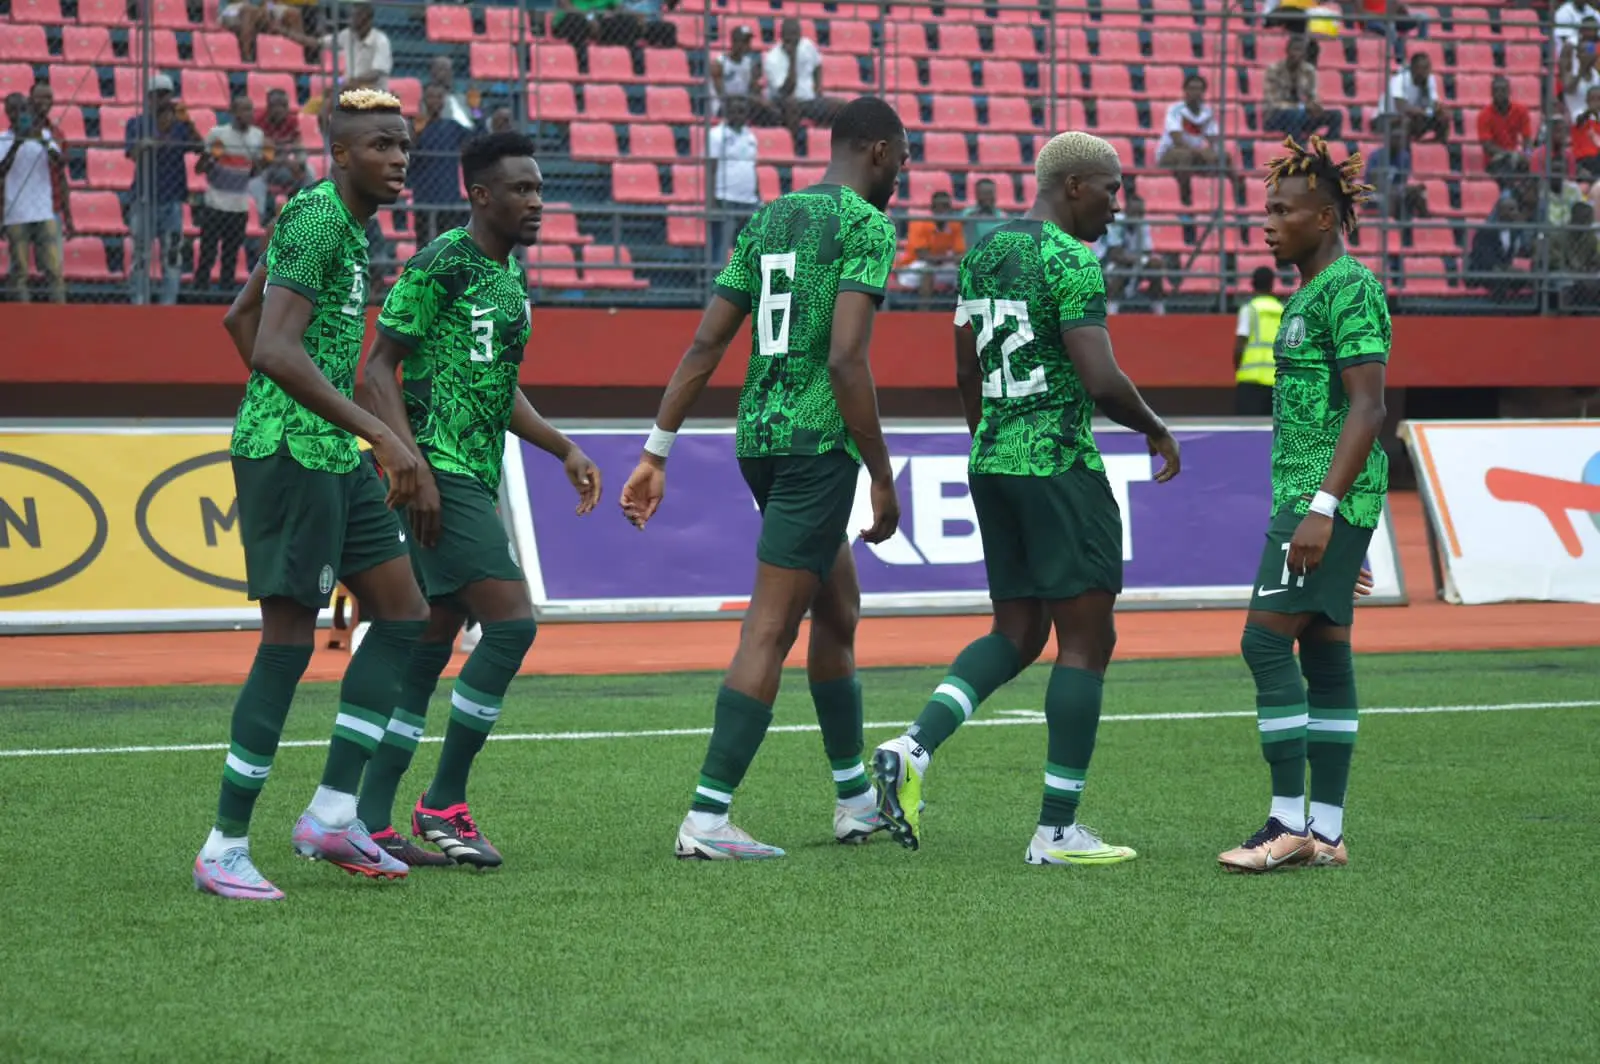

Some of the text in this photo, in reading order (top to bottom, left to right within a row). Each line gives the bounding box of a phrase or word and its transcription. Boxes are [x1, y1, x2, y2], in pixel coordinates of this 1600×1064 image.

[471, 319, 494, 361] 3
[758, 252, 796, 356] 6
[953, 295, 1048, 398] 22
